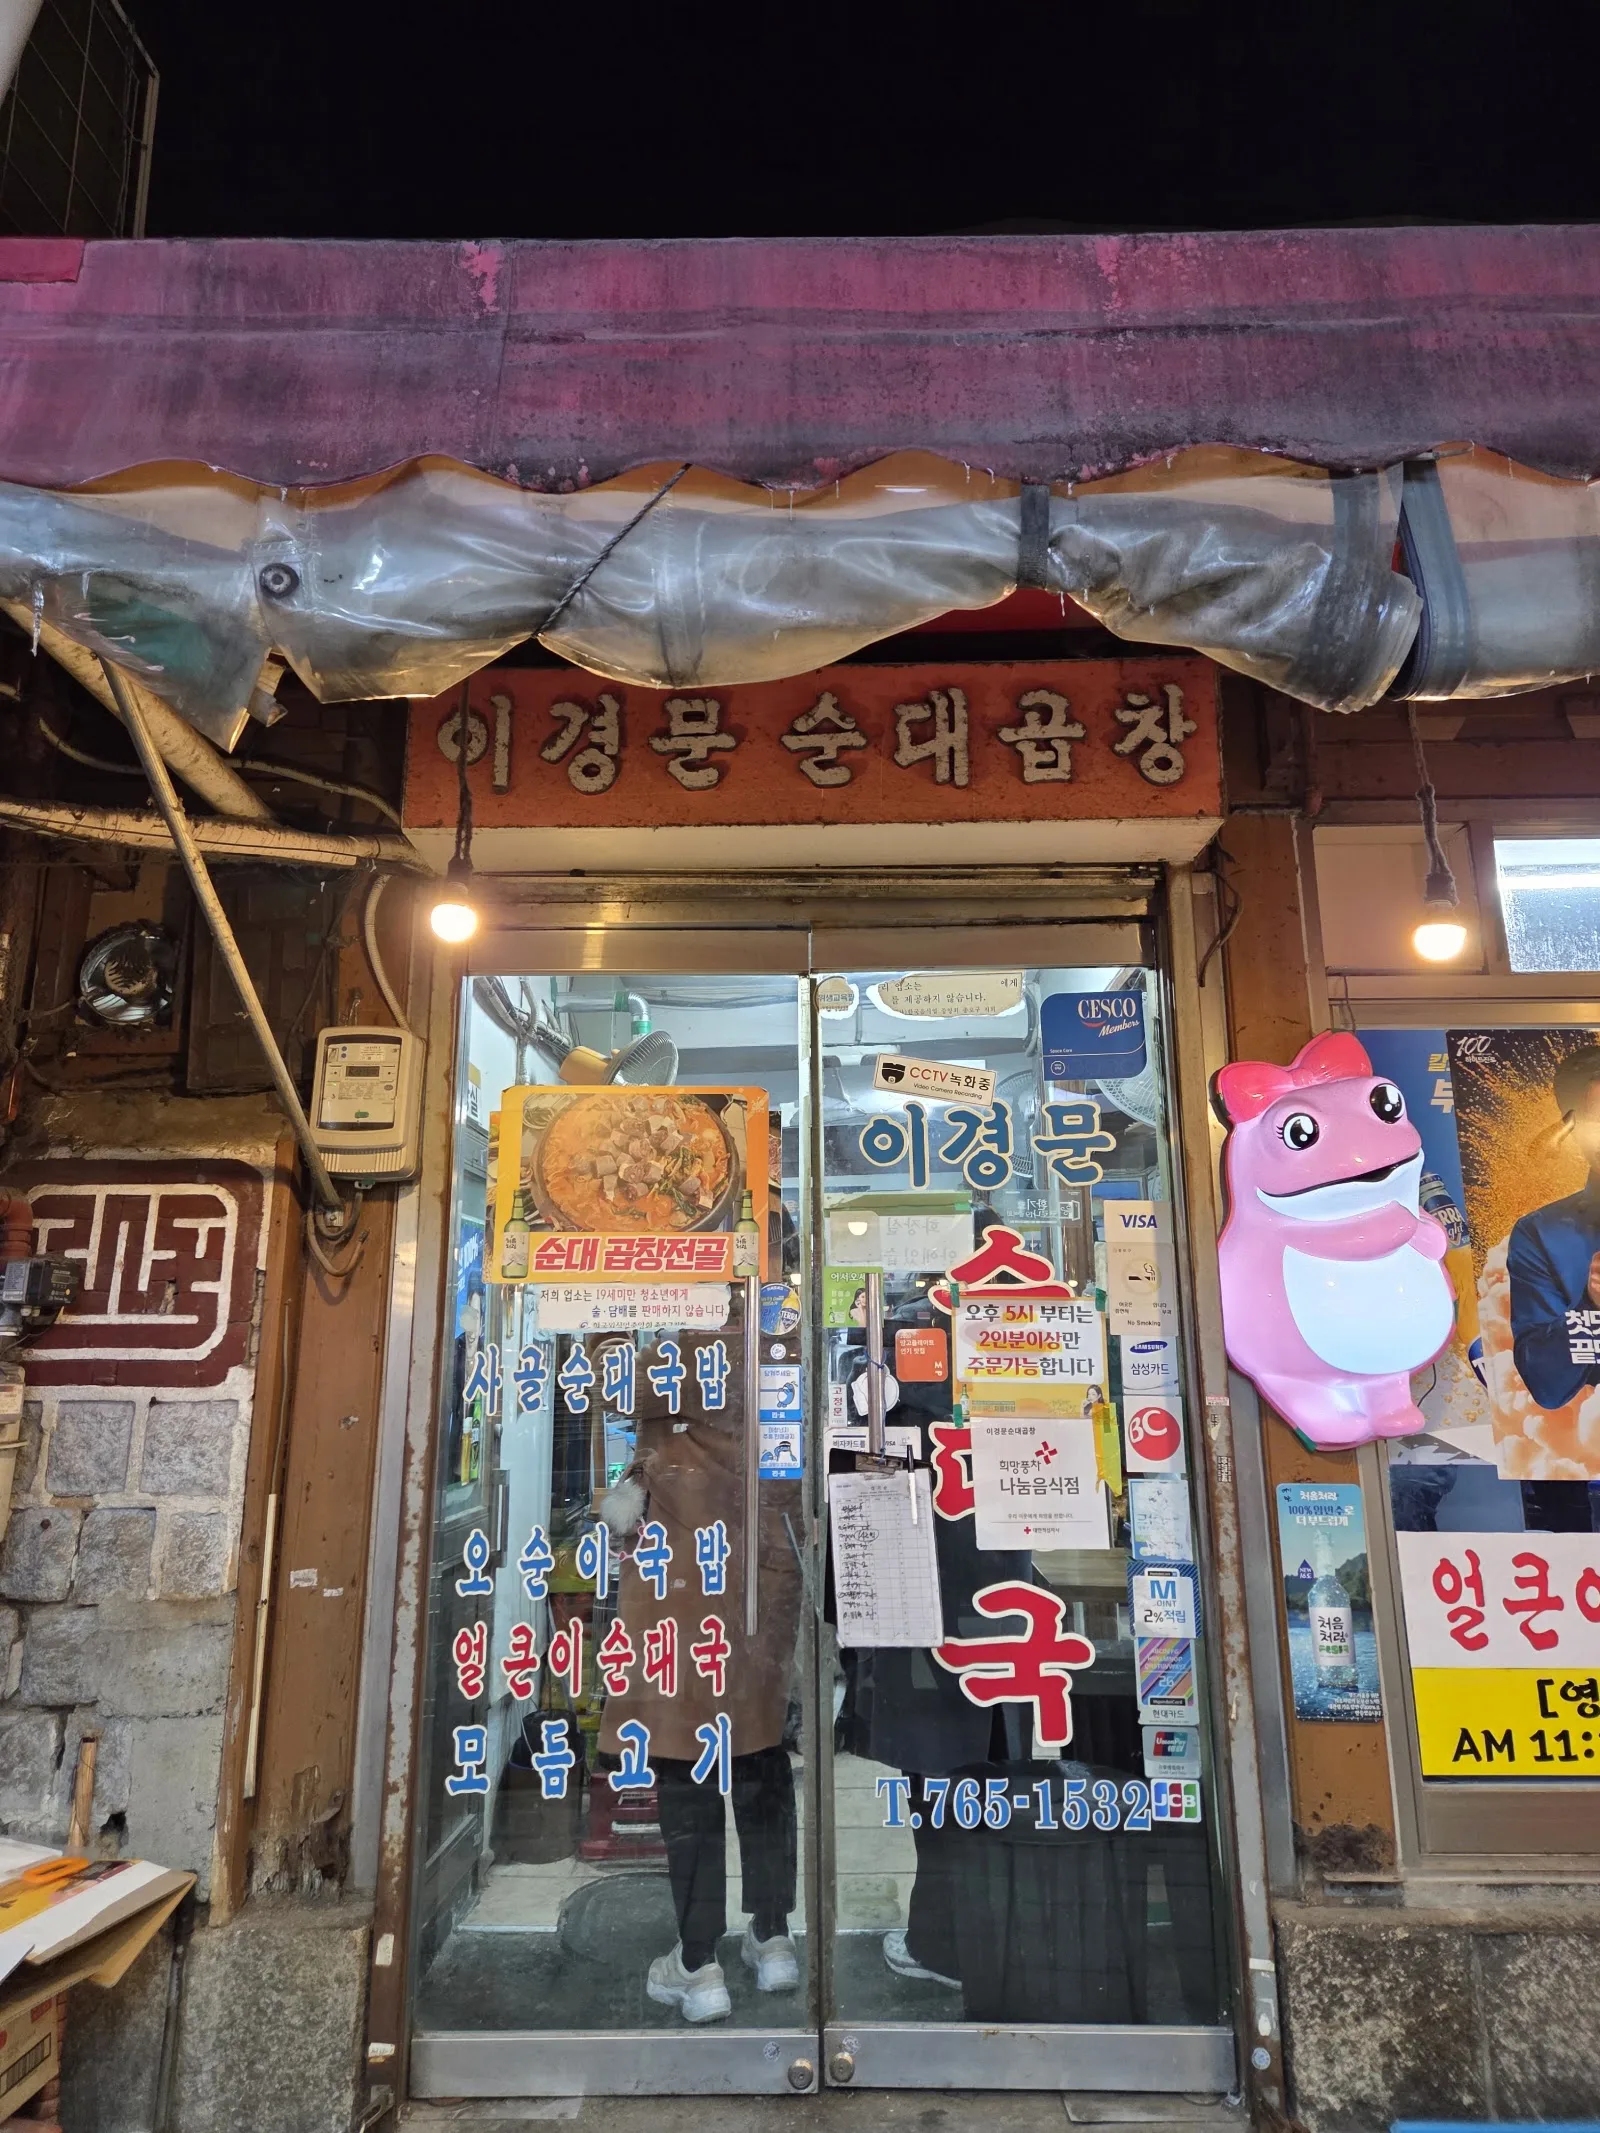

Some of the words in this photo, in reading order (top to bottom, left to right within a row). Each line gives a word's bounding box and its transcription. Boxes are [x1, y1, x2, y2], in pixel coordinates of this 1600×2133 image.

[878, 982, 889, 992] 리
[1078, 998, 1136, 1019] CESCO
[1098, 1018, 1140, 1037] Members
[1457, 1035, 1491, 1057] 100
[1428, 1053, 1450, 1072] 칼
[913, 1082, 929, 1091] Video
[930, 1085, 954, 1095] Camera
[954, 1089, 983, 1100] Recording
[859, 1100, 1117, 1191] 이경문
[1119, 1214, 1158, 1228] VISA
[534, 1237, 600, 1272] 순대
[603, 1236, 727, 1273] 곱창전골
[540, 1289, 559, 1302] 저희
[564, 1289, 592, 1302] 업소는
[596, 1288, 636, 1302] 19세미만
[640, 1288, 689, 1302] 청소년에게
[641, 1305, 681, 1318] 판매하지
[685, 1305, 728, 1318] 않습니다.
[965, 1303, 1000, 1323] 오후
[1006, 1304, 1034, 1323] 5시
[1040, 1305, 1094, 1324] 부터는
[1137, 1319, 1161, 1327] Smoking
[979, 1330, 1081, 1350] 2인분이상만
[967, 1356, 1095, 1377] 주문가능합니다
[1130, 1362, 1170, 1376] 삼성카드
[1130, 1410, 1168, 1444] BC
[1000, 1459, 1042, 1475] 희망풍차
[1000, 1476, 1080, 1496] 나눔음식점
[1150, 1580, 1176, 1599] M
[1154, 1599, 1177, 1608] OINT
[1318, 1616, 1344, 1630] 처음
[1319, 1630, 1346, 1643] 처럼
[1158, 1675, 1174, 1687] 26
[1152, 1709, 1185, 1719] 현대카드
[1156, 1737, 1186, 1746] UnionPay
[1452, 1727, 1516, 1763] AM
[1529, 1729, 1600, 1762] 11:
[876, 1778, 1151, 1831] T.765-1532
[1154, 1793, 1197, 1808] JCB
